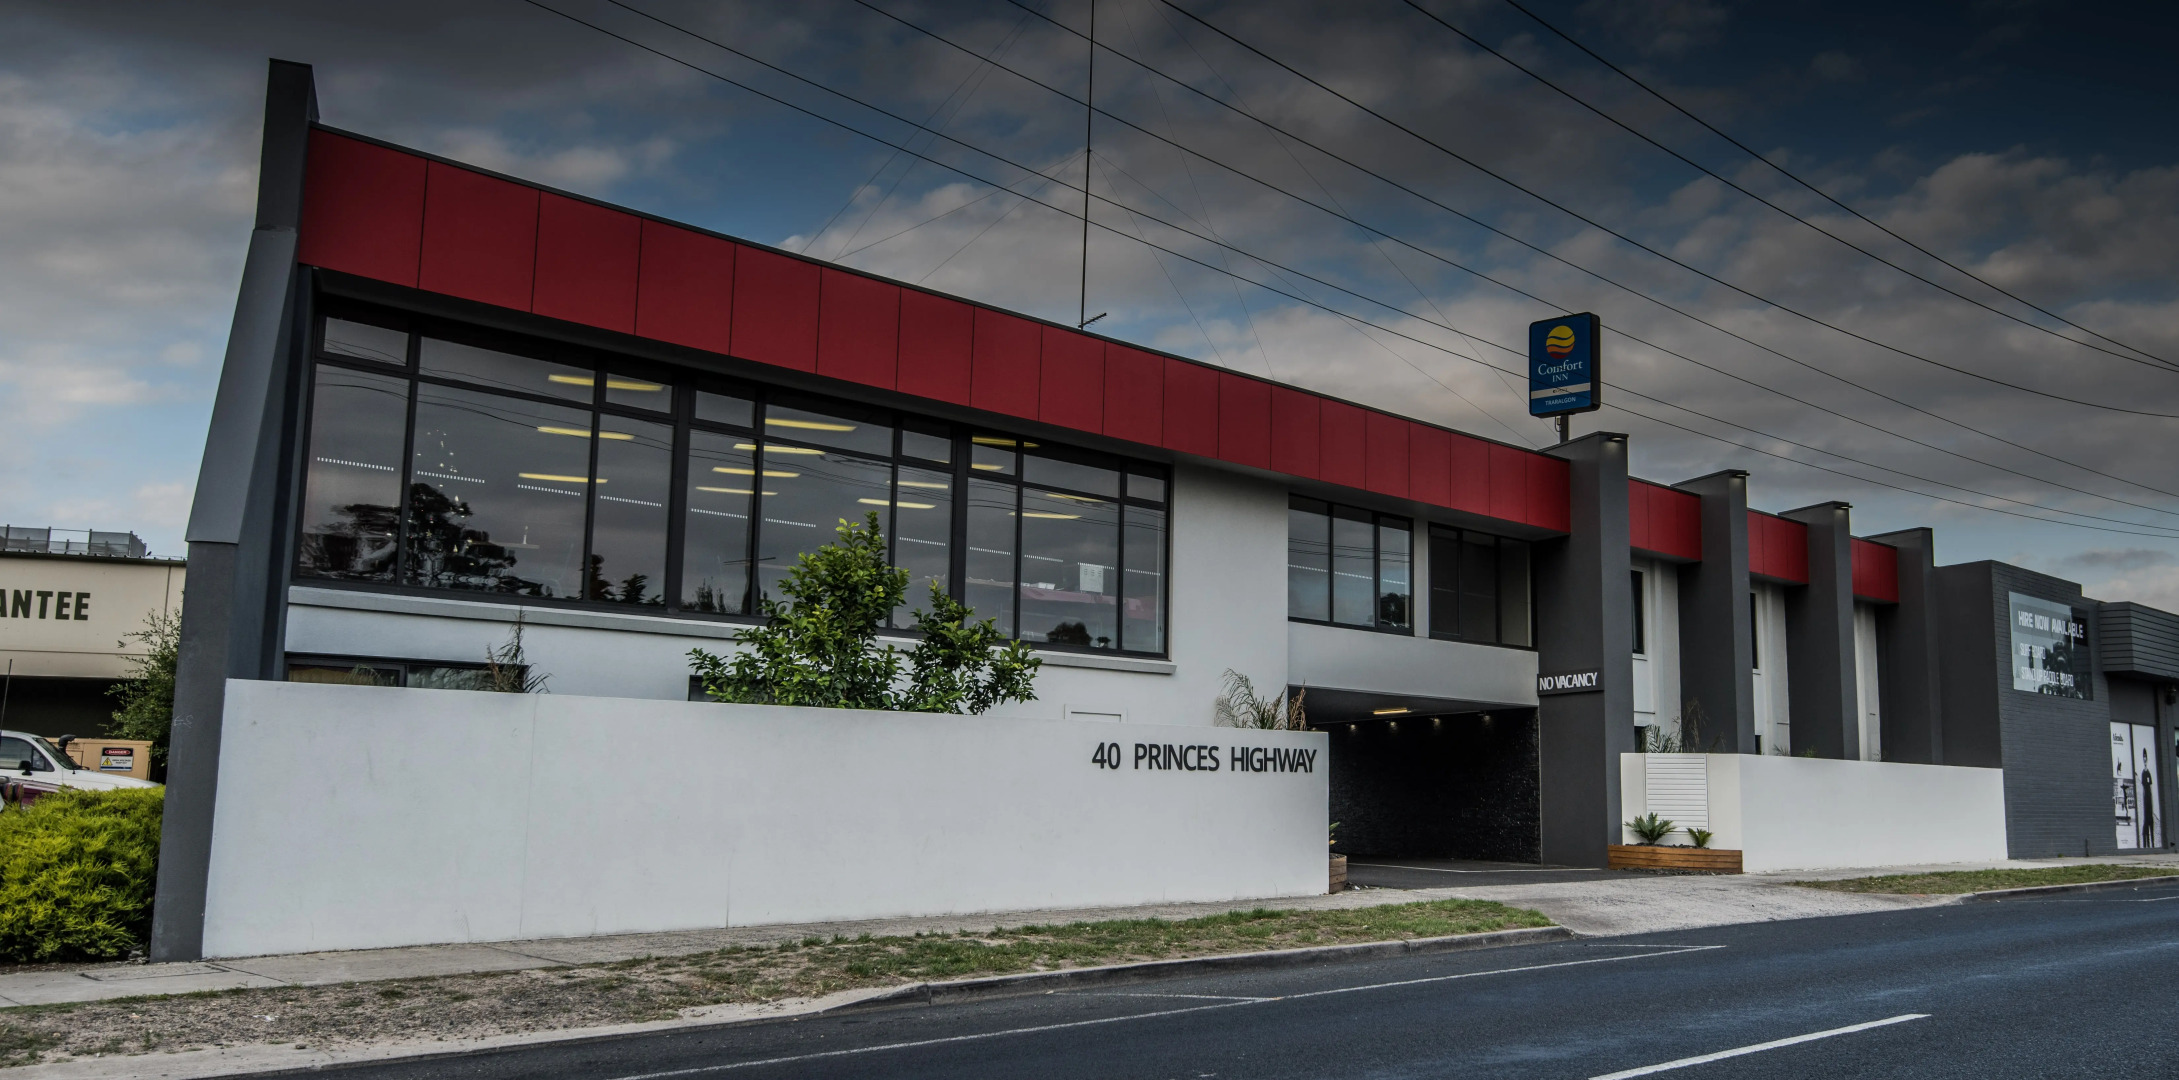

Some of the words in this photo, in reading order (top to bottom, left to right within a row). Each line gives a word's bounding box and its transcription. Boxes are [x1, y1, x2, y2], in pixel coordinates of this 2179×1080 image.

[1537, 359, 1583, 375] Comfort
[1552, 373, 1568, 382] INN
[2018, 610, 2034, 628] HIRE
[2034, 614, 2050, 632] NOW
[2051, 617, 2084, 639] AVAILABLE
[1539, 677, 1554, 690] NO
[1555, 672, 1598, 689] VACANCY
[1091, 742, 1121, 770] 40
[1134, 743, 1220, 772] PRINCES
[1231, 746, 1317, 774] HIGHWAY
